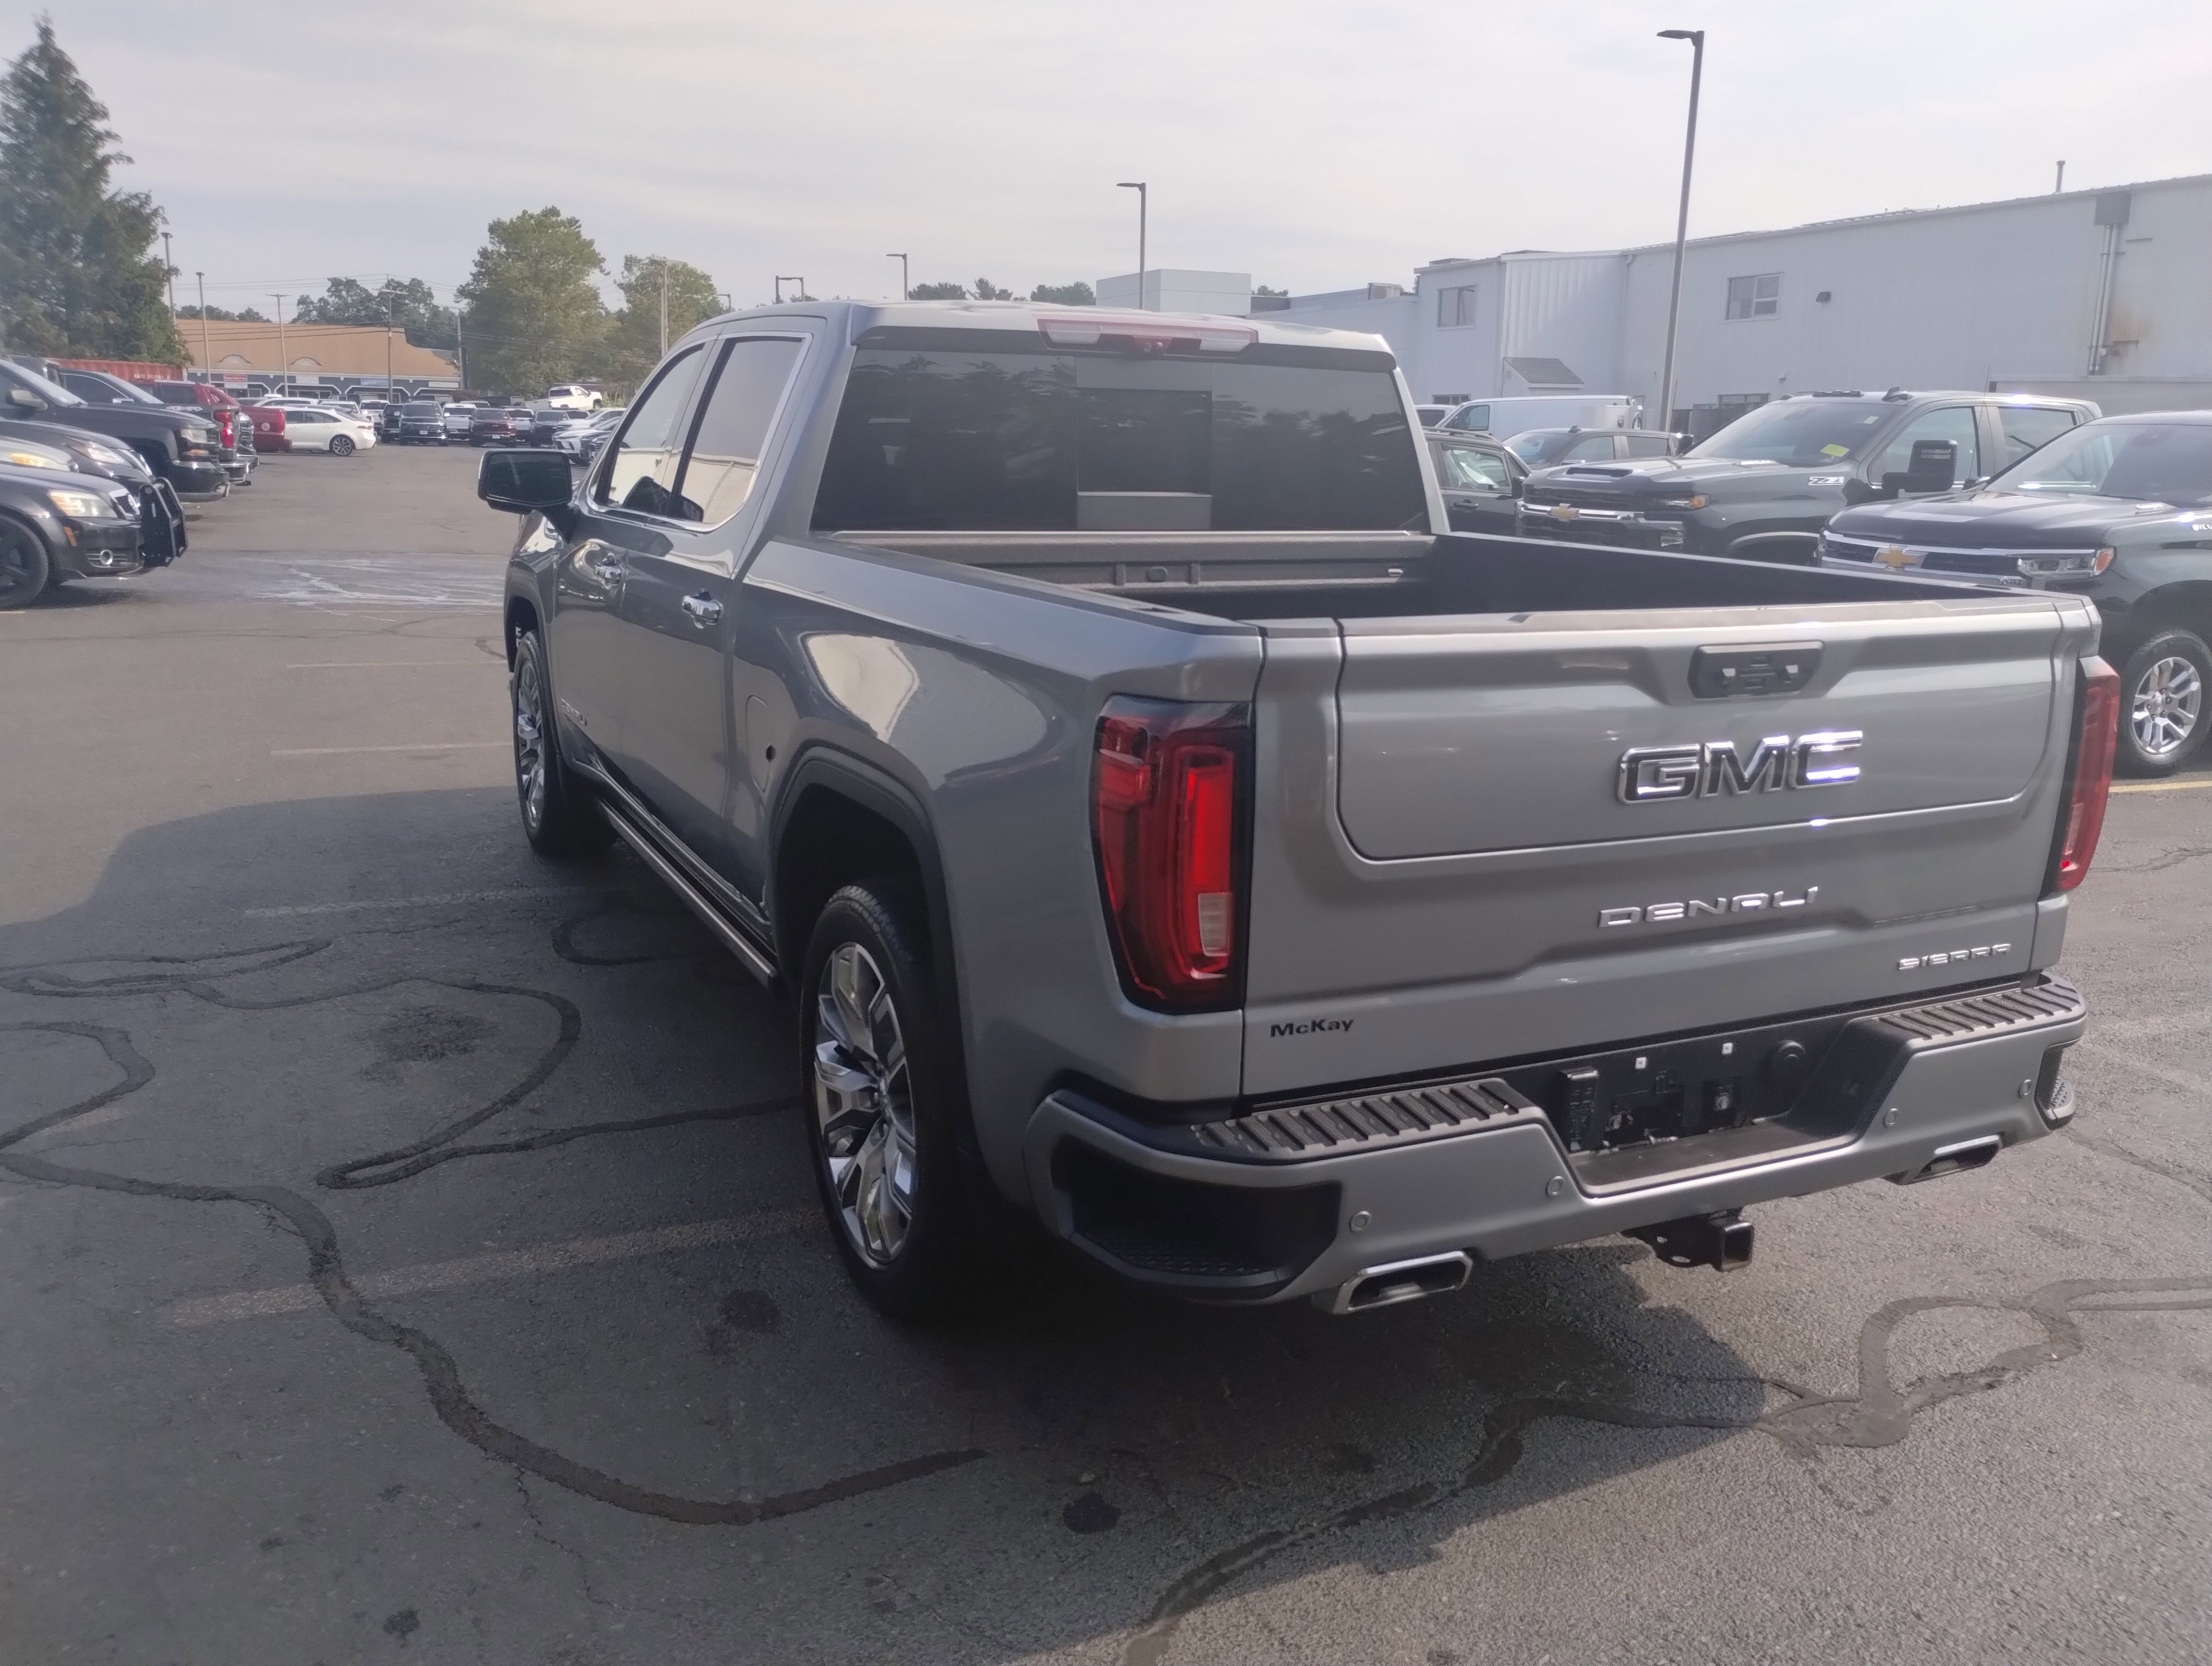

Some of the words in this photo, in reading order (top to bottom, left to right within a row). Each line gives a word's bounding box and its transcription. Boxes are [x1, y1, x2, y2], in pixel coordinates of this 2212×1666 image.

[1808, 476, 1844, 486] Z71
[1616, 730, 1863, 805] GMC
[1598, 886, 1819, 928] DENALI
[1898, 943, 2011, 970] SIERRA
[1270, 1018, 1354, 1037] McKay
